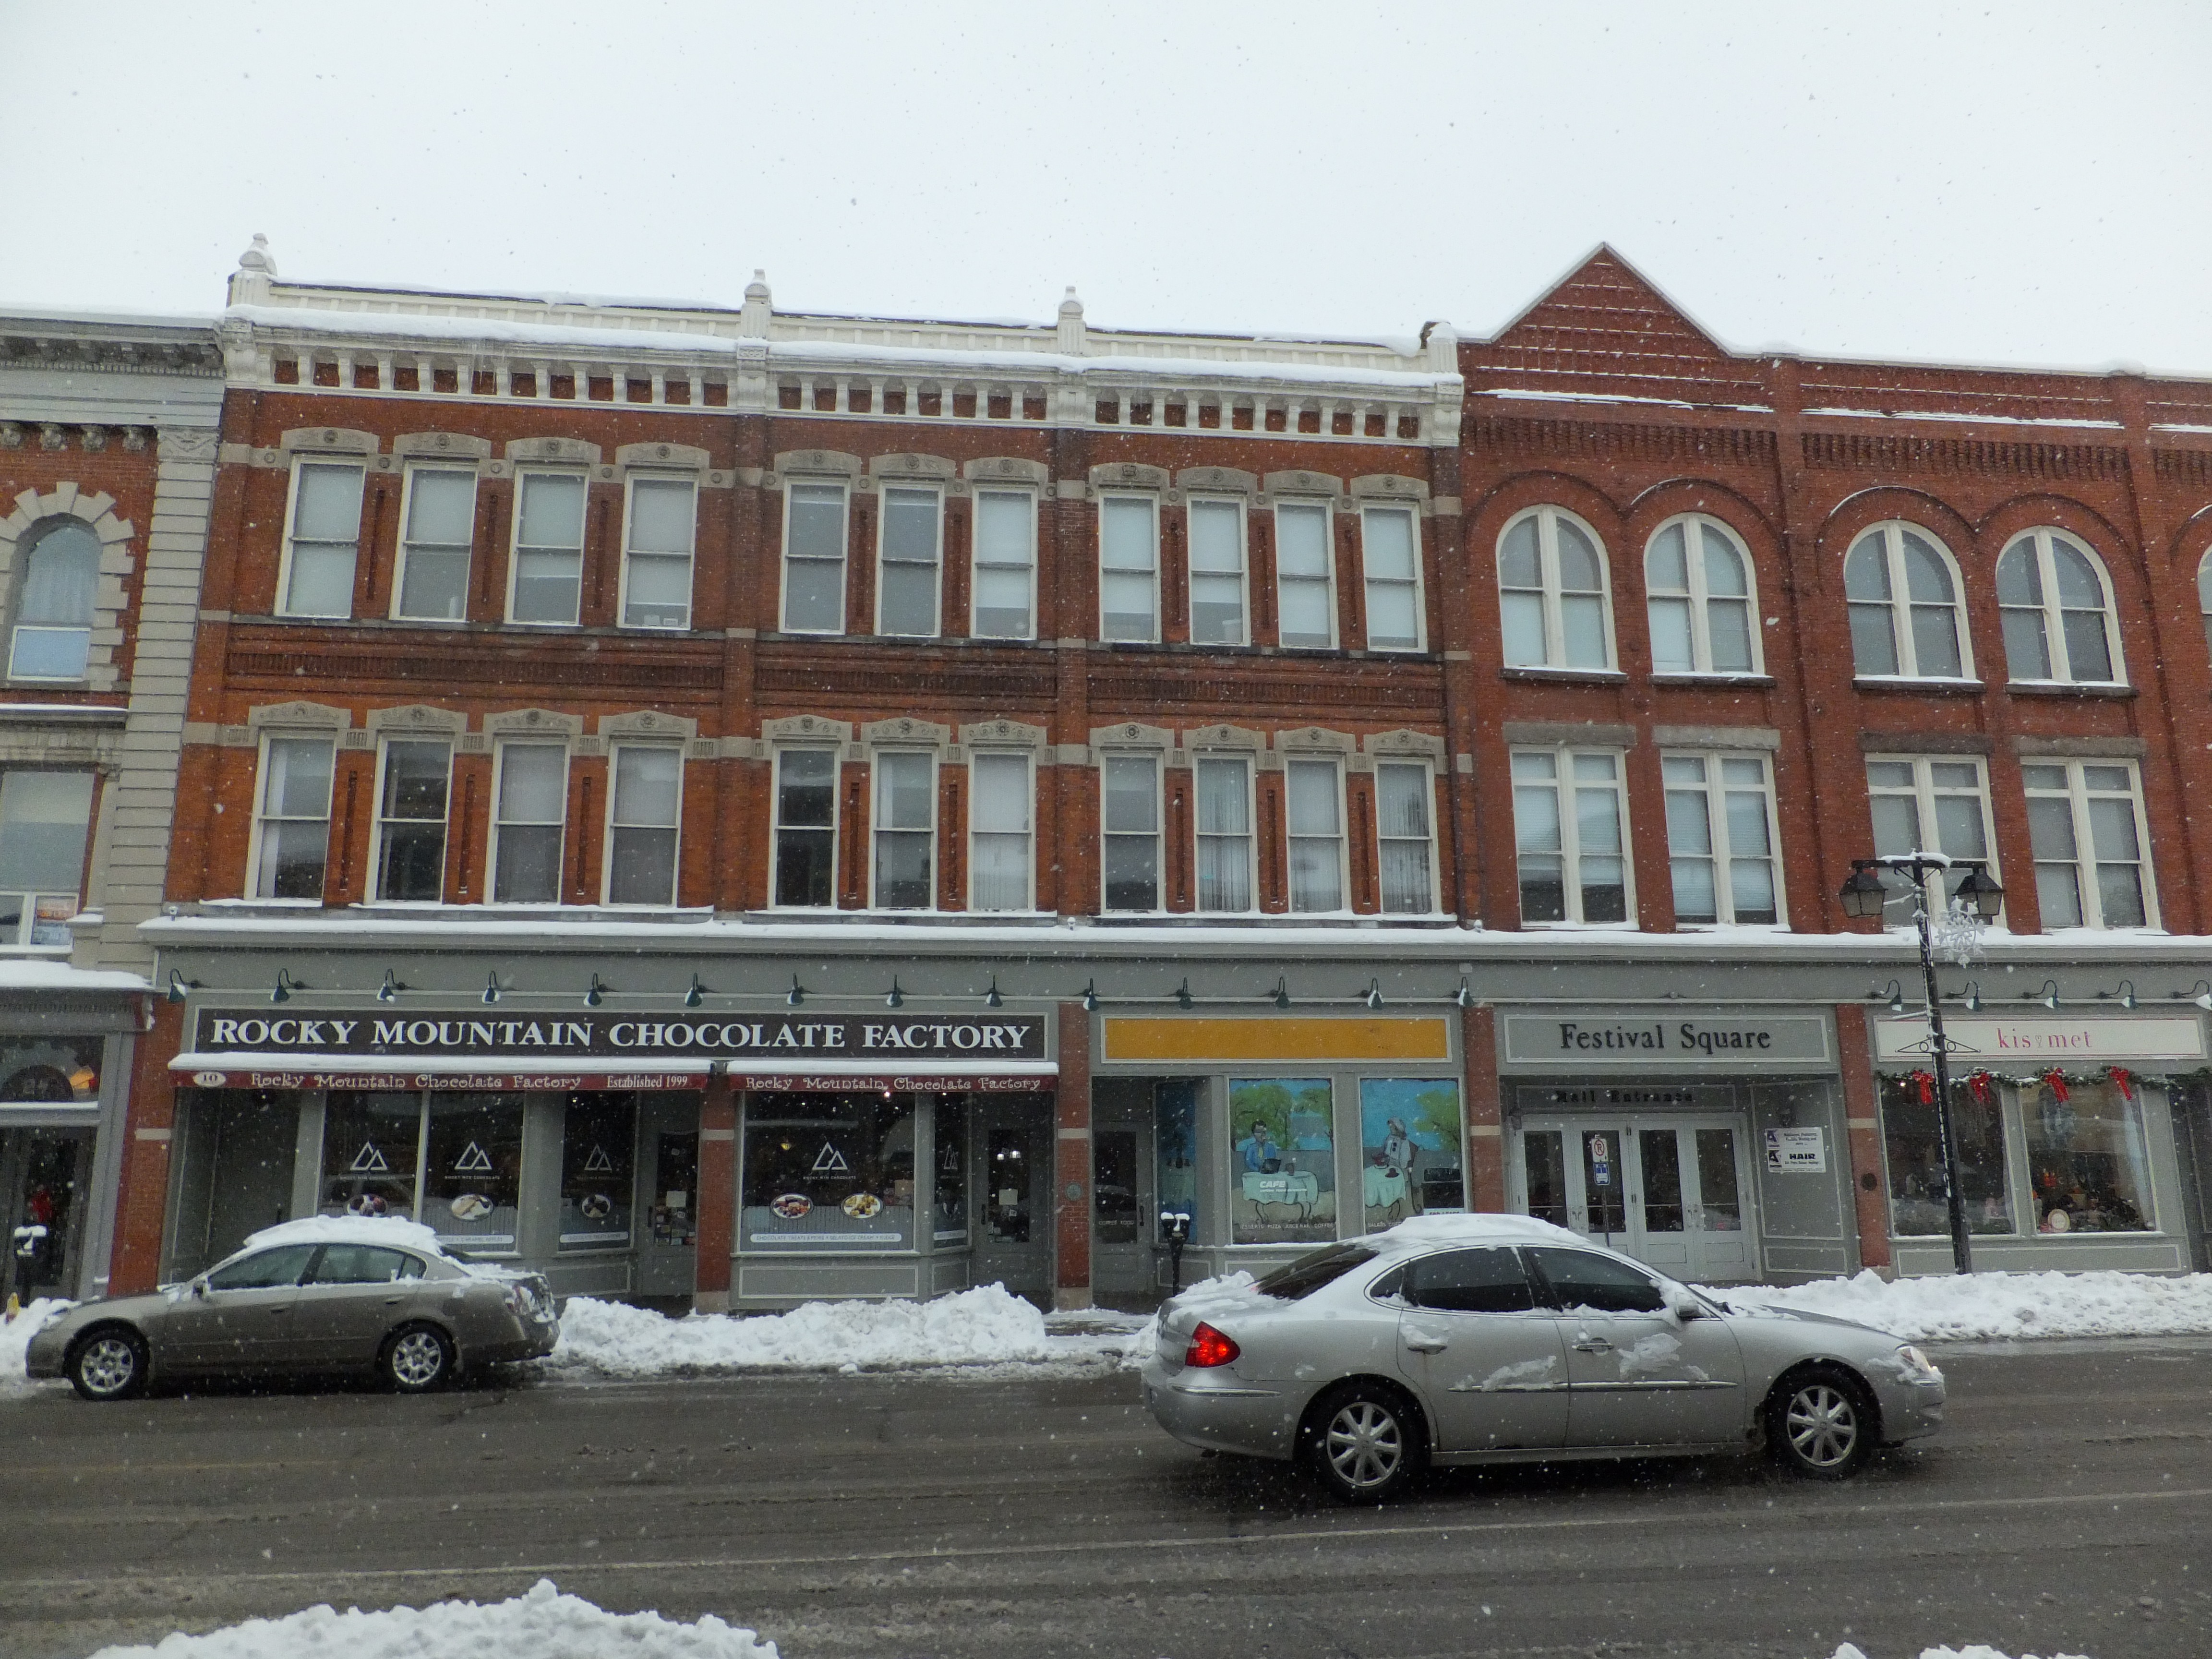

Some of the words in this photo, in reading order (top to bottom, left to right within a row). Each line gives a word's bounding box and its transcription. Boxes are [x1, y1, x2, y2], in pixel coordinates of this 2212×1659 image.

[211, 1019, 359, 1045] ROCKY
[371, 1021, 593, 1046] MOUNTAIN
[609, 1023, 845, 1047] CHOCOLATE
[862, 1024, 1030, 1049] FACTORY
[1559, 1023, 1665, 1049] Festival
[1680, 1023, 1771, 1055] Square
[251, 1073, 305, 1088] Rocky
[314, 1074, 406, 1088] Mountain
[415, 1074, 502, 1088] Chocolate
[513, 1074, 581, 1090] Factory
[606, 1075, 662, 1088] Established
[666, 1075, 688, 1087] 1999
[745, 1077, 792, 1090] Rocky
[803, 1078, 884, 1089] Mountain
[893, 1077, 971, 1090] Chocolate
[978, 1078, 1041, 1091] Factory
